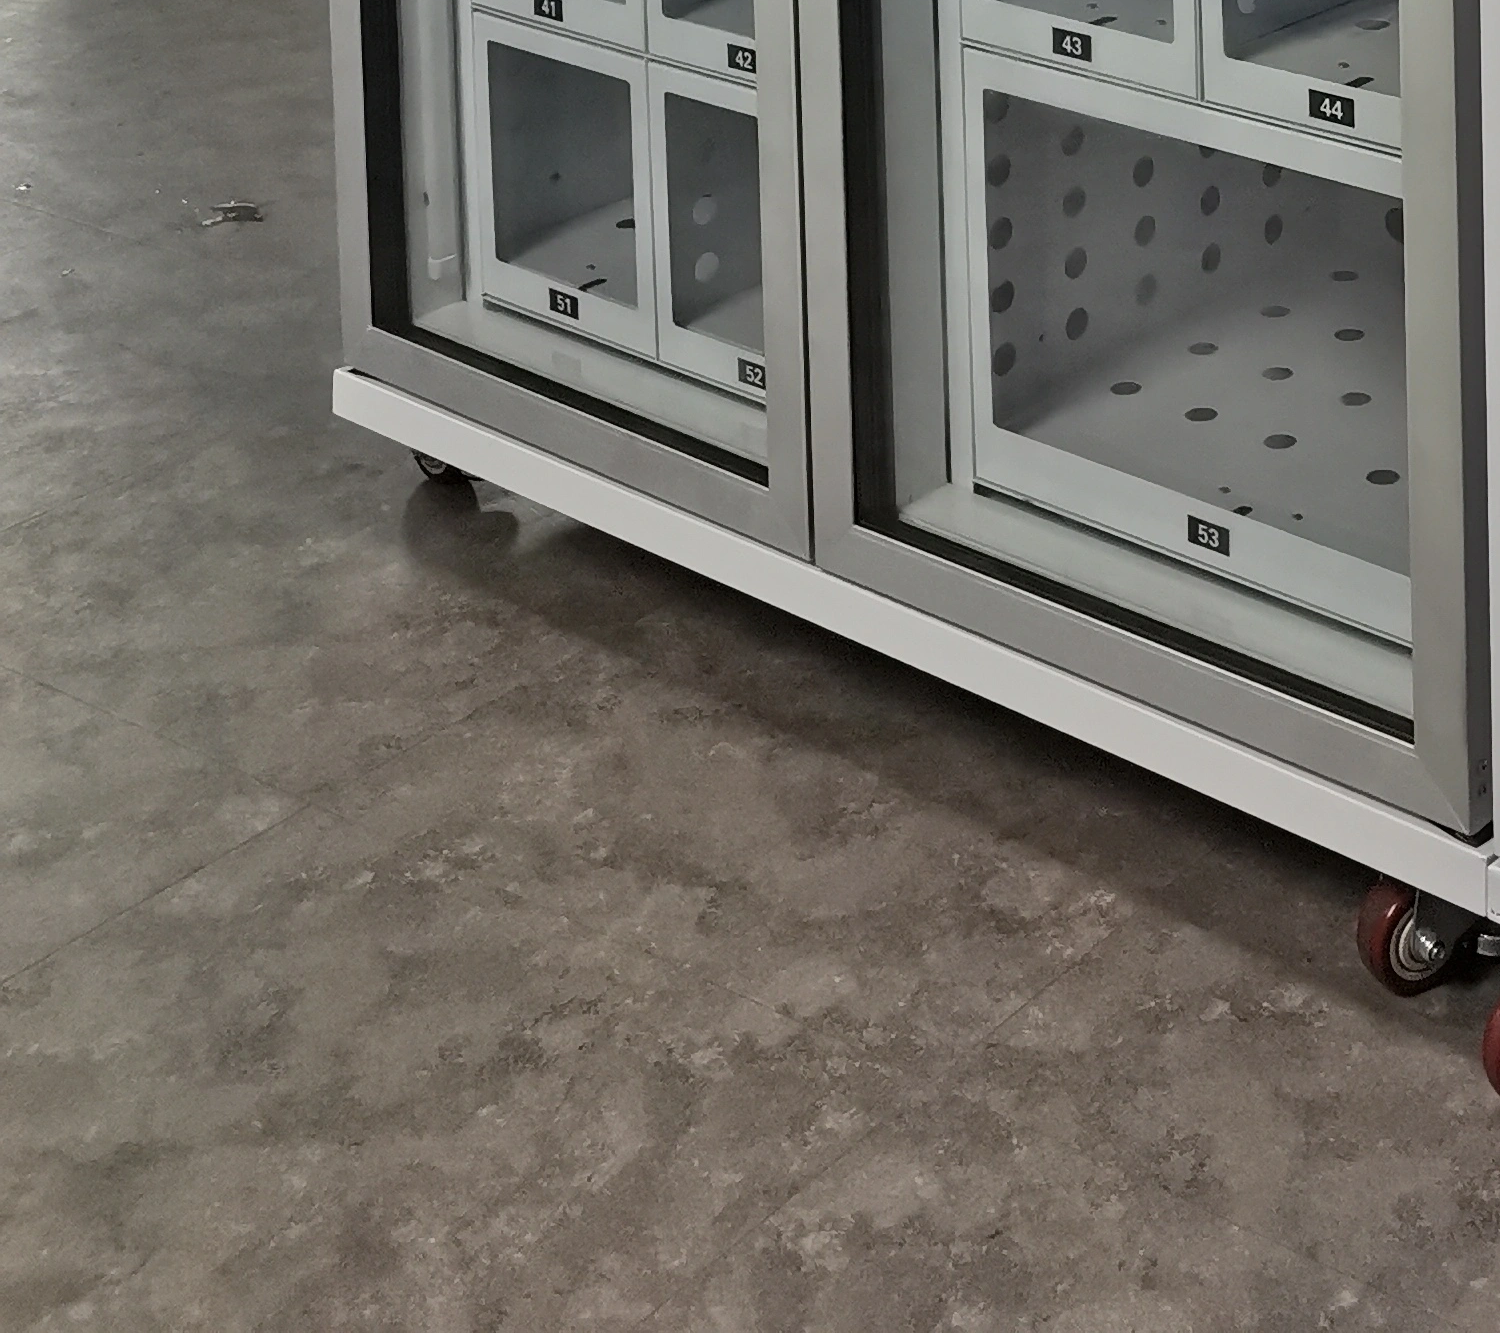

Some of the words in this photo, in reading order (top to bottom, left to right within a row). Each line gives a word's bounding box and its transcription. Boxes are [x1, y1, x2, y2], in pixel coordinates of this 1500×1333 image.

[541, 0, 556, 17] 41
[1061, 35, 1082, 56] 43
[735, 49, 753, 70] 42
[1319, 97, 1344, 120] 44
[556, 294, 572, 315] 51
[745, 364, 763, 387] 52
[1197, 523, 1220, 548] 53
